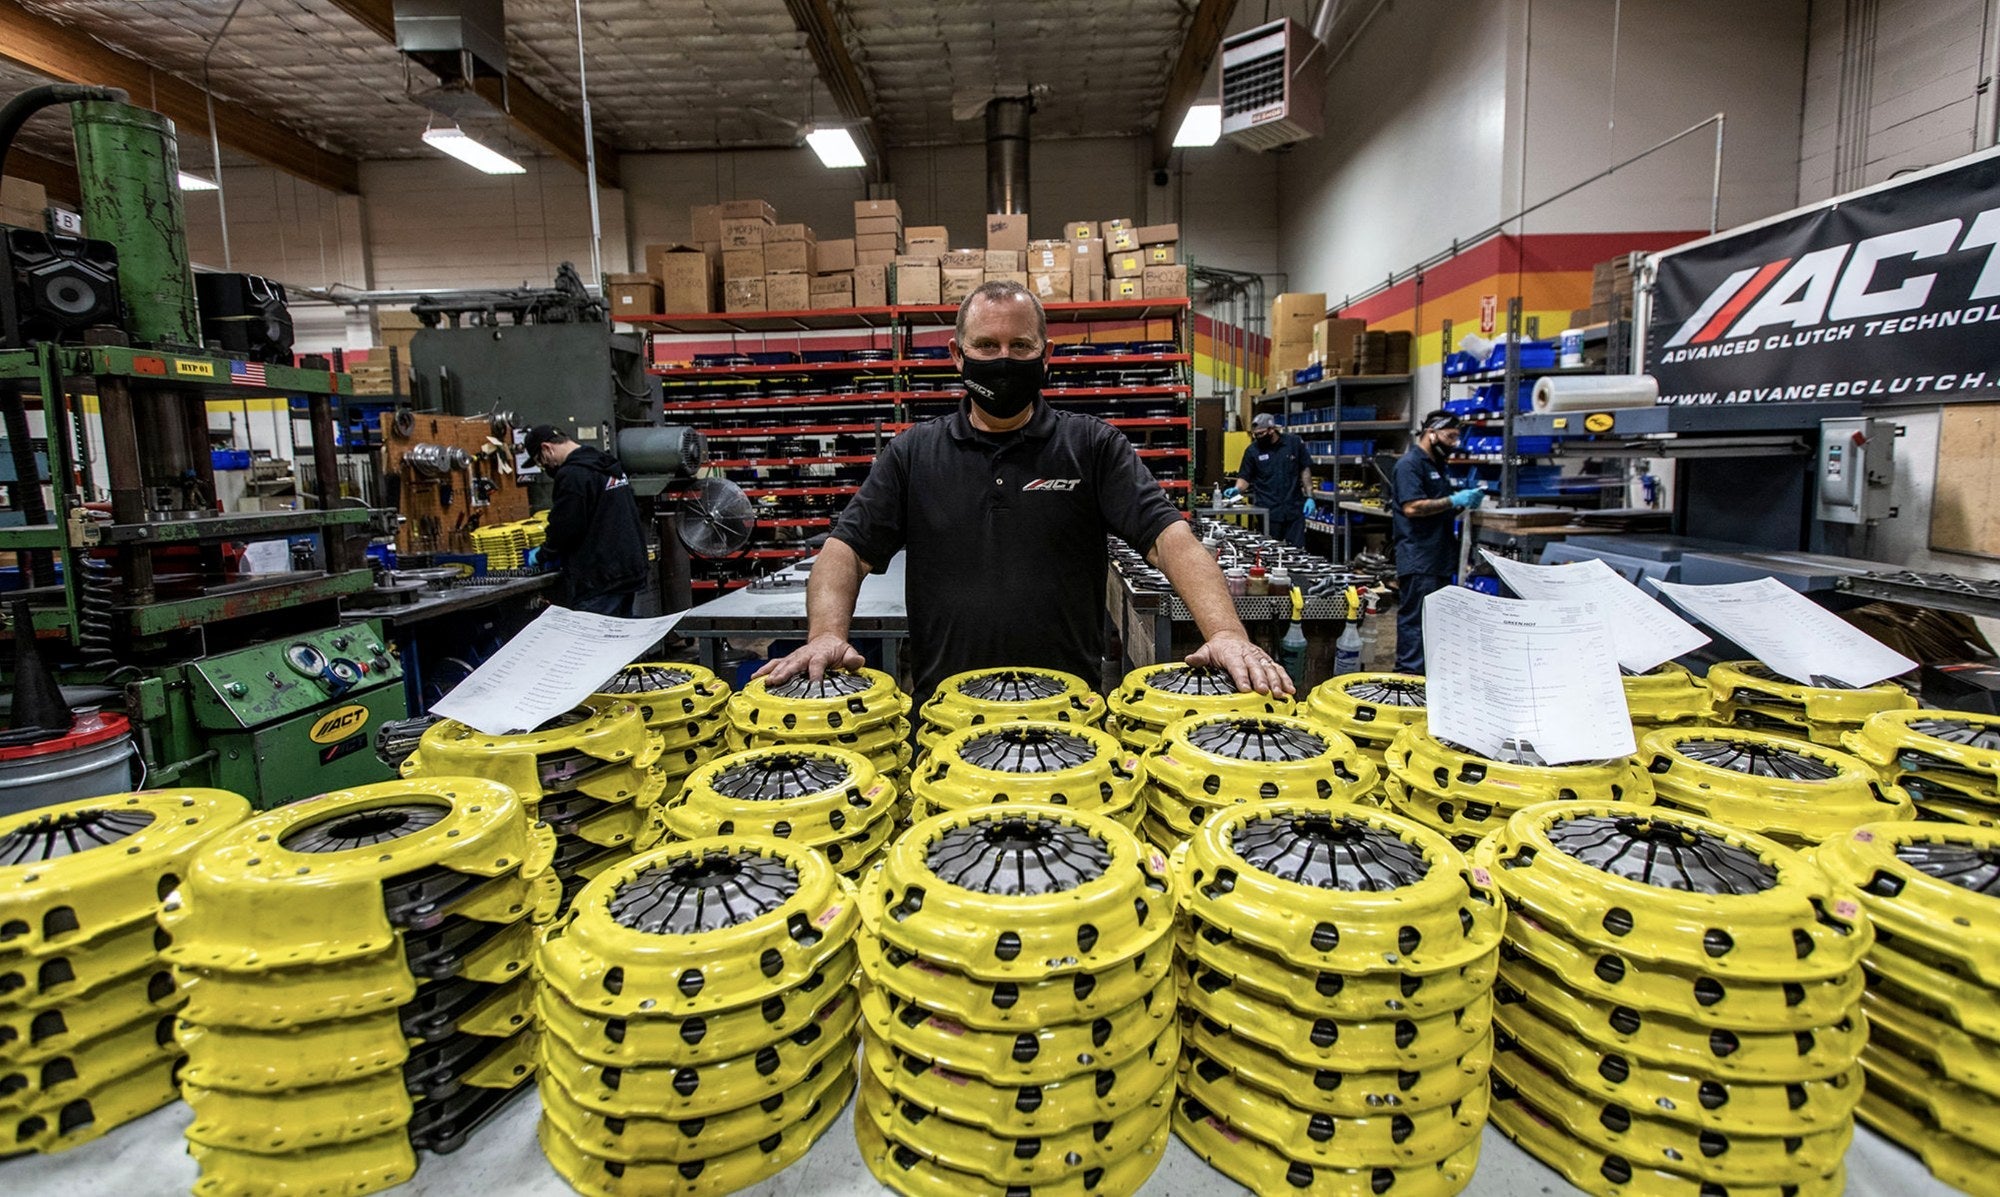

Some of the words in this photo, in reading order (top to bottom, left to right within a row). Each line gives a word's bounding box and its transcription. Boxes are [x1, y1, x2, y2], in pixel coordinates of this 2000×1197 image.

[1660, 339, 1760, 364] ADVANCED
[1764, 324, 1855, 350] CLUTCH
[182, 363, 198, 372] HYP
[1657, 372, 2000, 406] WWW.ADVANCEDCLUTCH.
